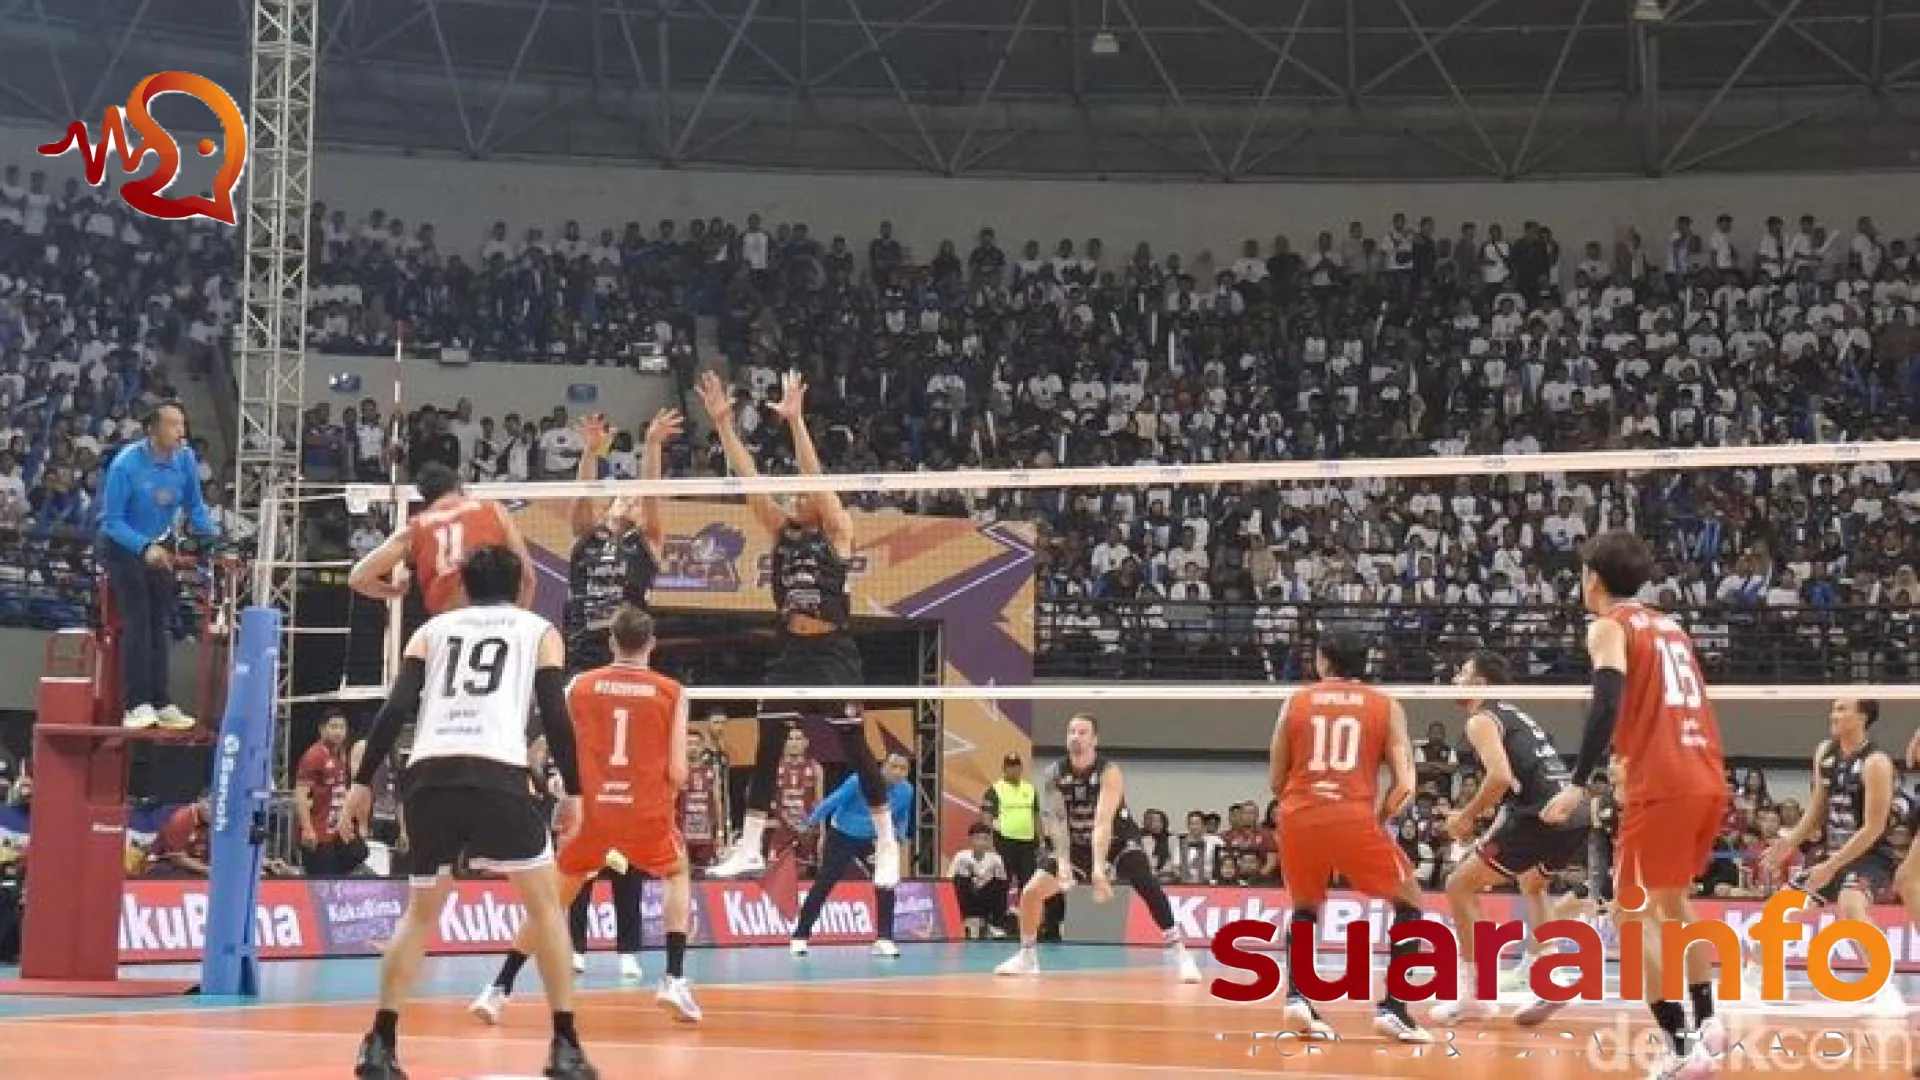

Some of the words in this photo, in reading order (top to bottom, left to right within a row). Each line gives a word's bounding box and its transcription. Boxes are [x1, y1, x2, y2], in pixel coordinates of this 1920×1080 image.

[442, 636, 509, 697] 19
[609, 708, 629, 766] 1
[1308, 714, 1361, 772] 10
